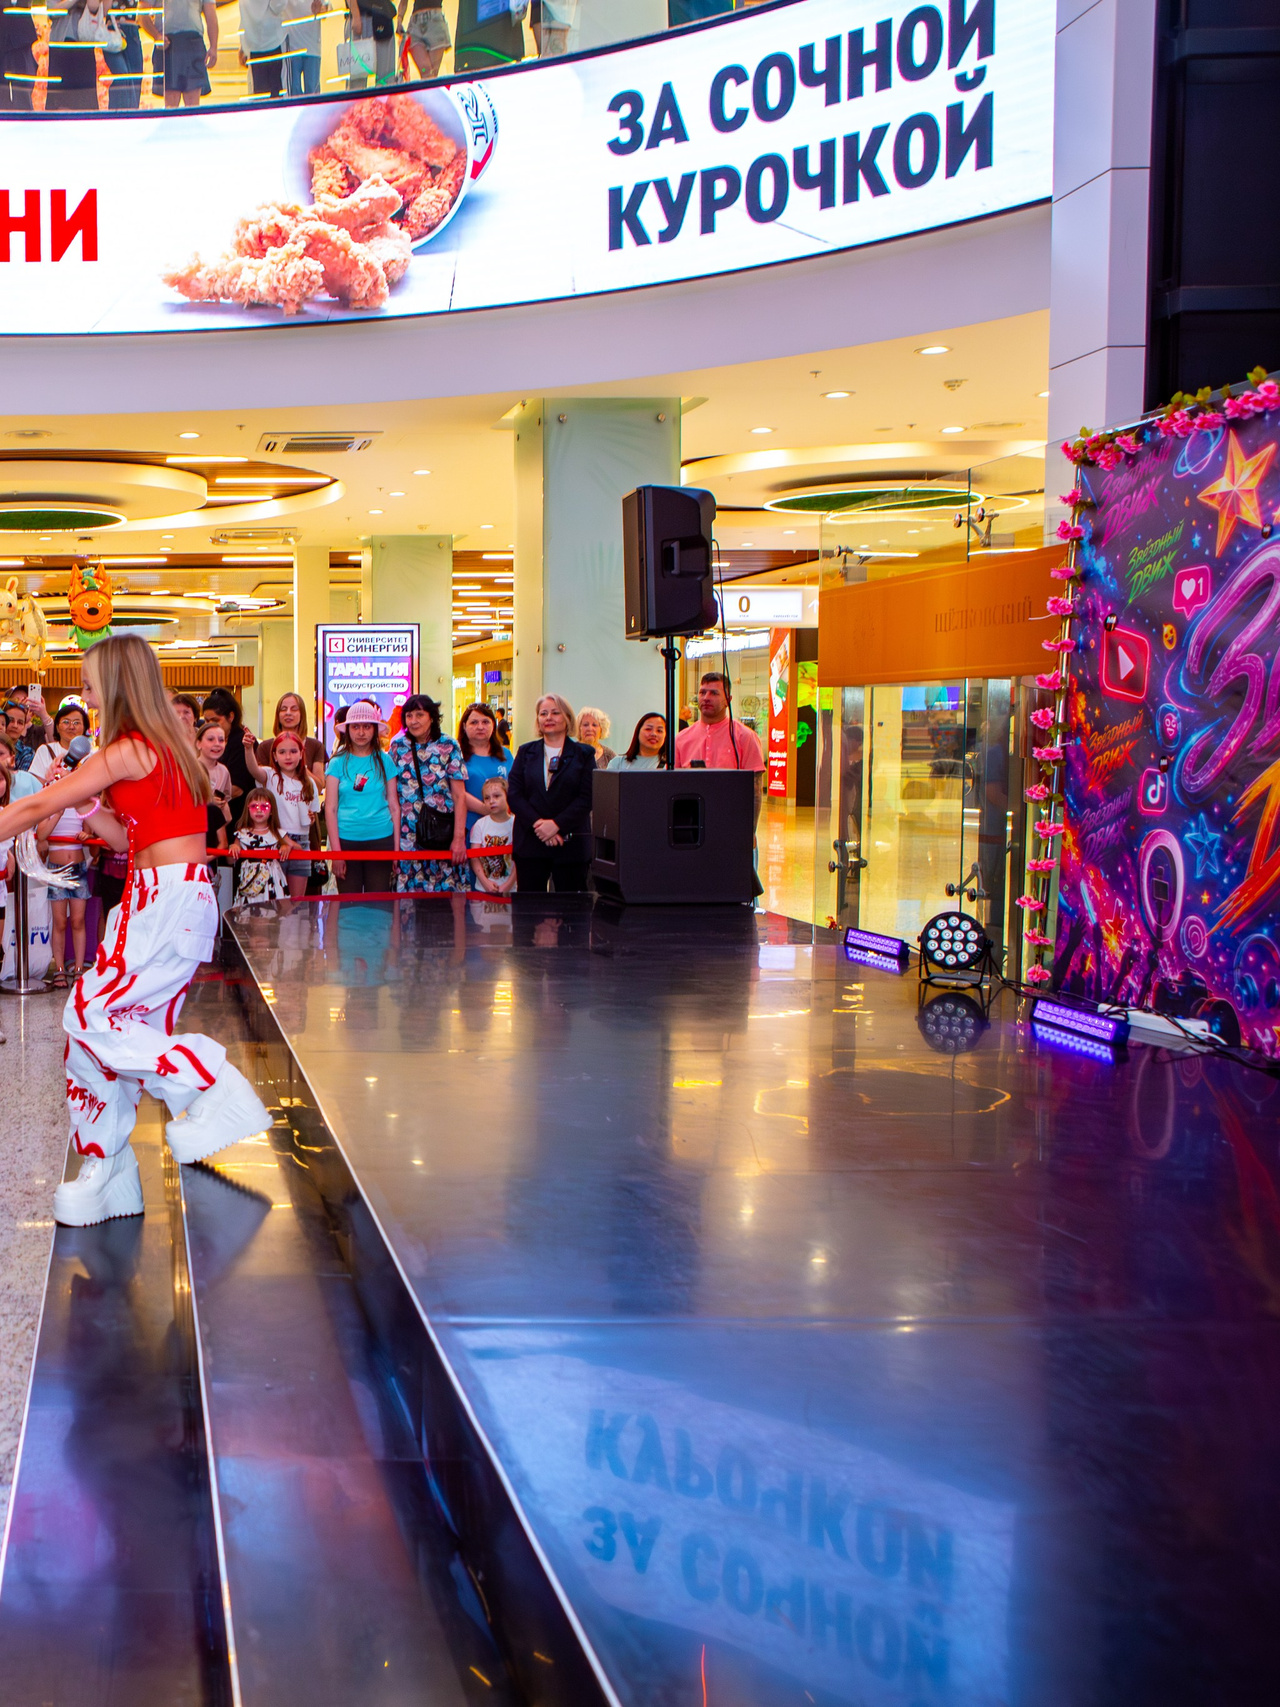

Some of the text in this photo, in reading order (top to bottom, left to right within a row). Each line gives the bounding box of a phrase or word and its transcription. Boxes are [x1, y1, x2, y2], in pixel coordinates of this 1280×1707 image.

[607, 81, 689, 156] ЗА
[608, 65, 994, 252] КУРОЧКОЙ
[347, 644, 408, 653] СИНЕРГИЯ
[328, 662, 409, 677] ГАРАНТИЯ
[333, 682, 404, 690] трудоустройства
